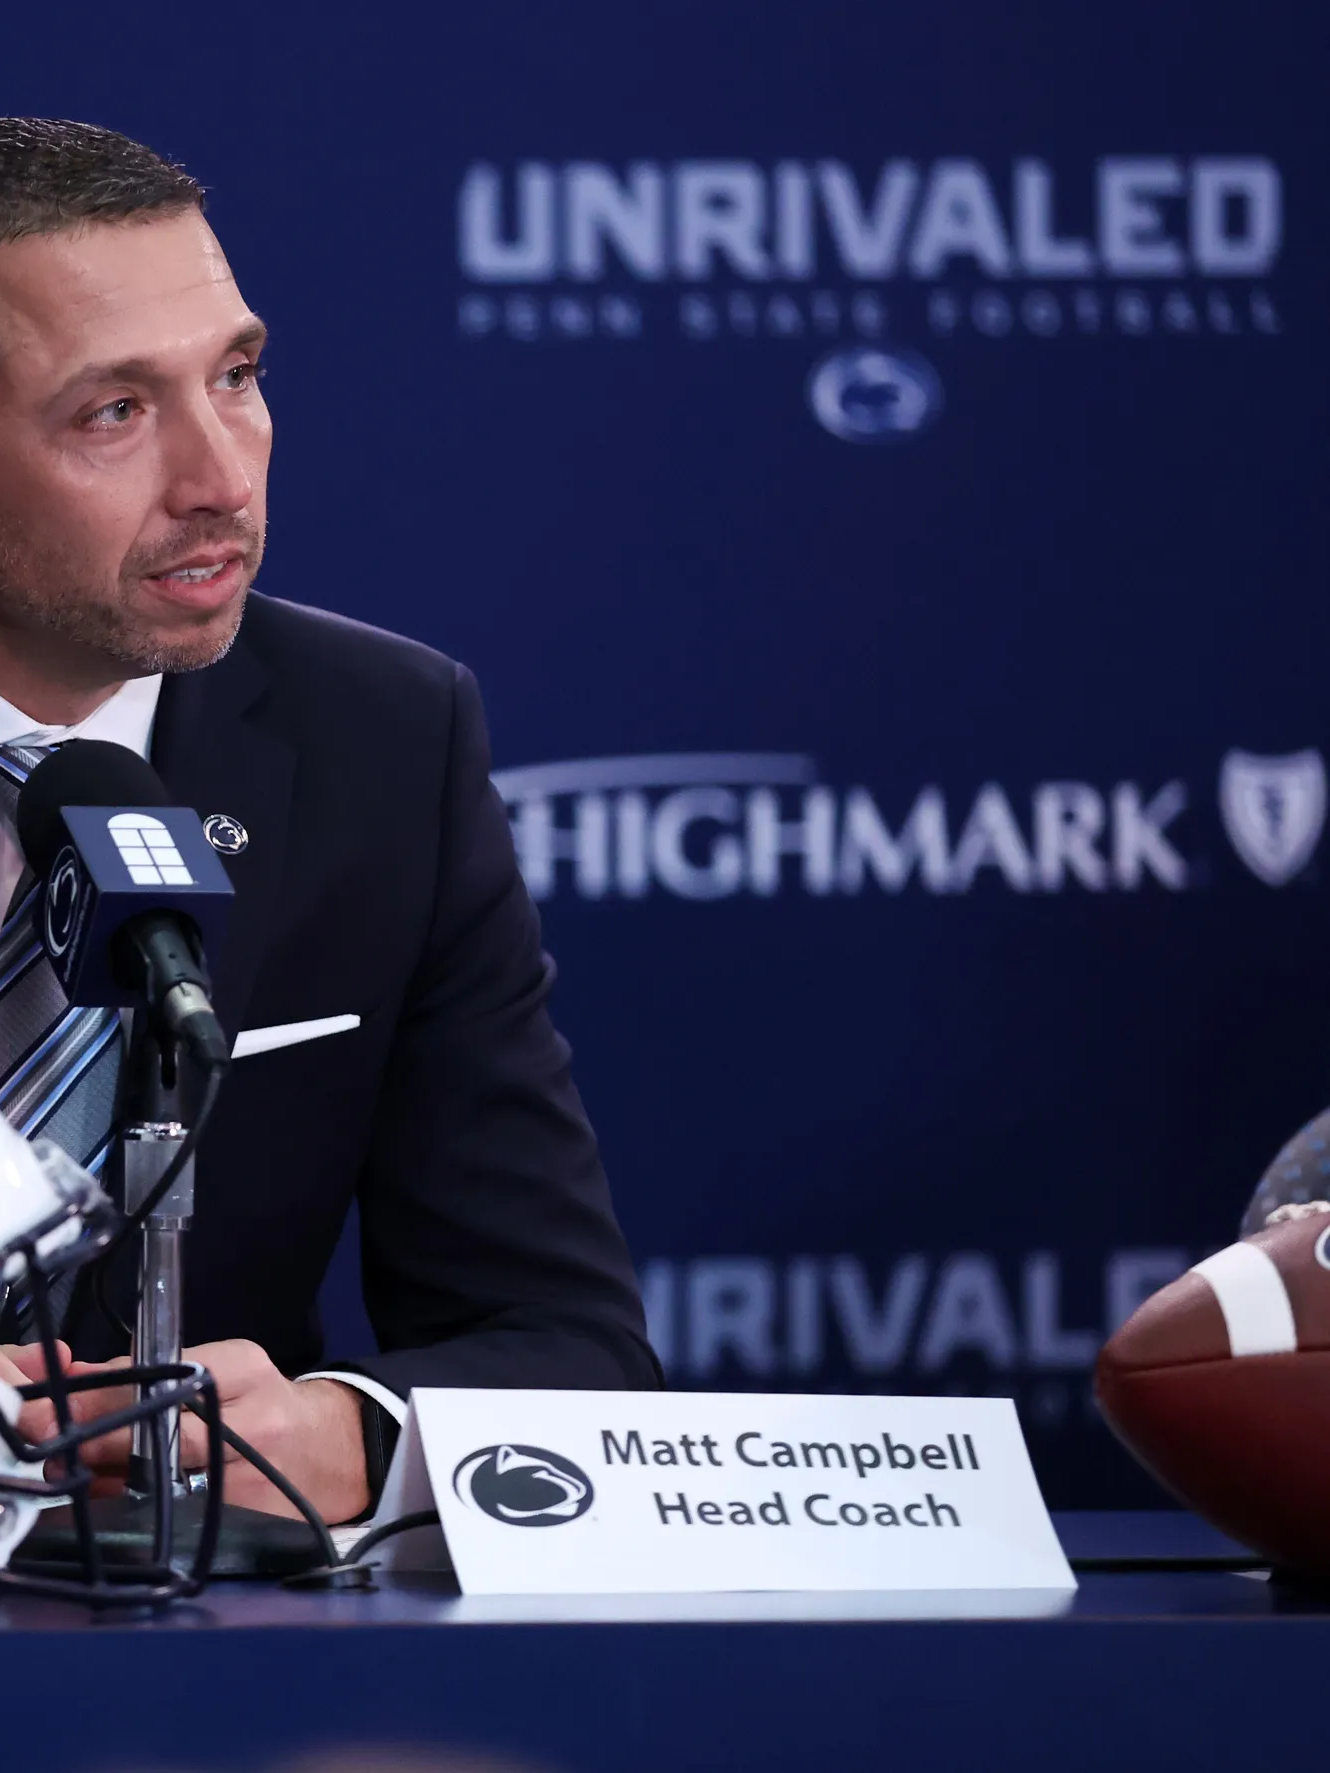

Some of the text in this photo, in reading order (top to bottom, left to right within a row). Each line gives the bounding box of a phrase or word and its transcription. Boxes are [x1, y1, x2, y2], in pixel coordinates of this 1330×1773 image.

[460, 157, 1283, 281] UNRIVALED
[518, 781, 1187, 899] HIGHMARK
[600, 1429, 981, 1479] Matt Campbell
[653, 1491, 961, 1527] Head Coach
